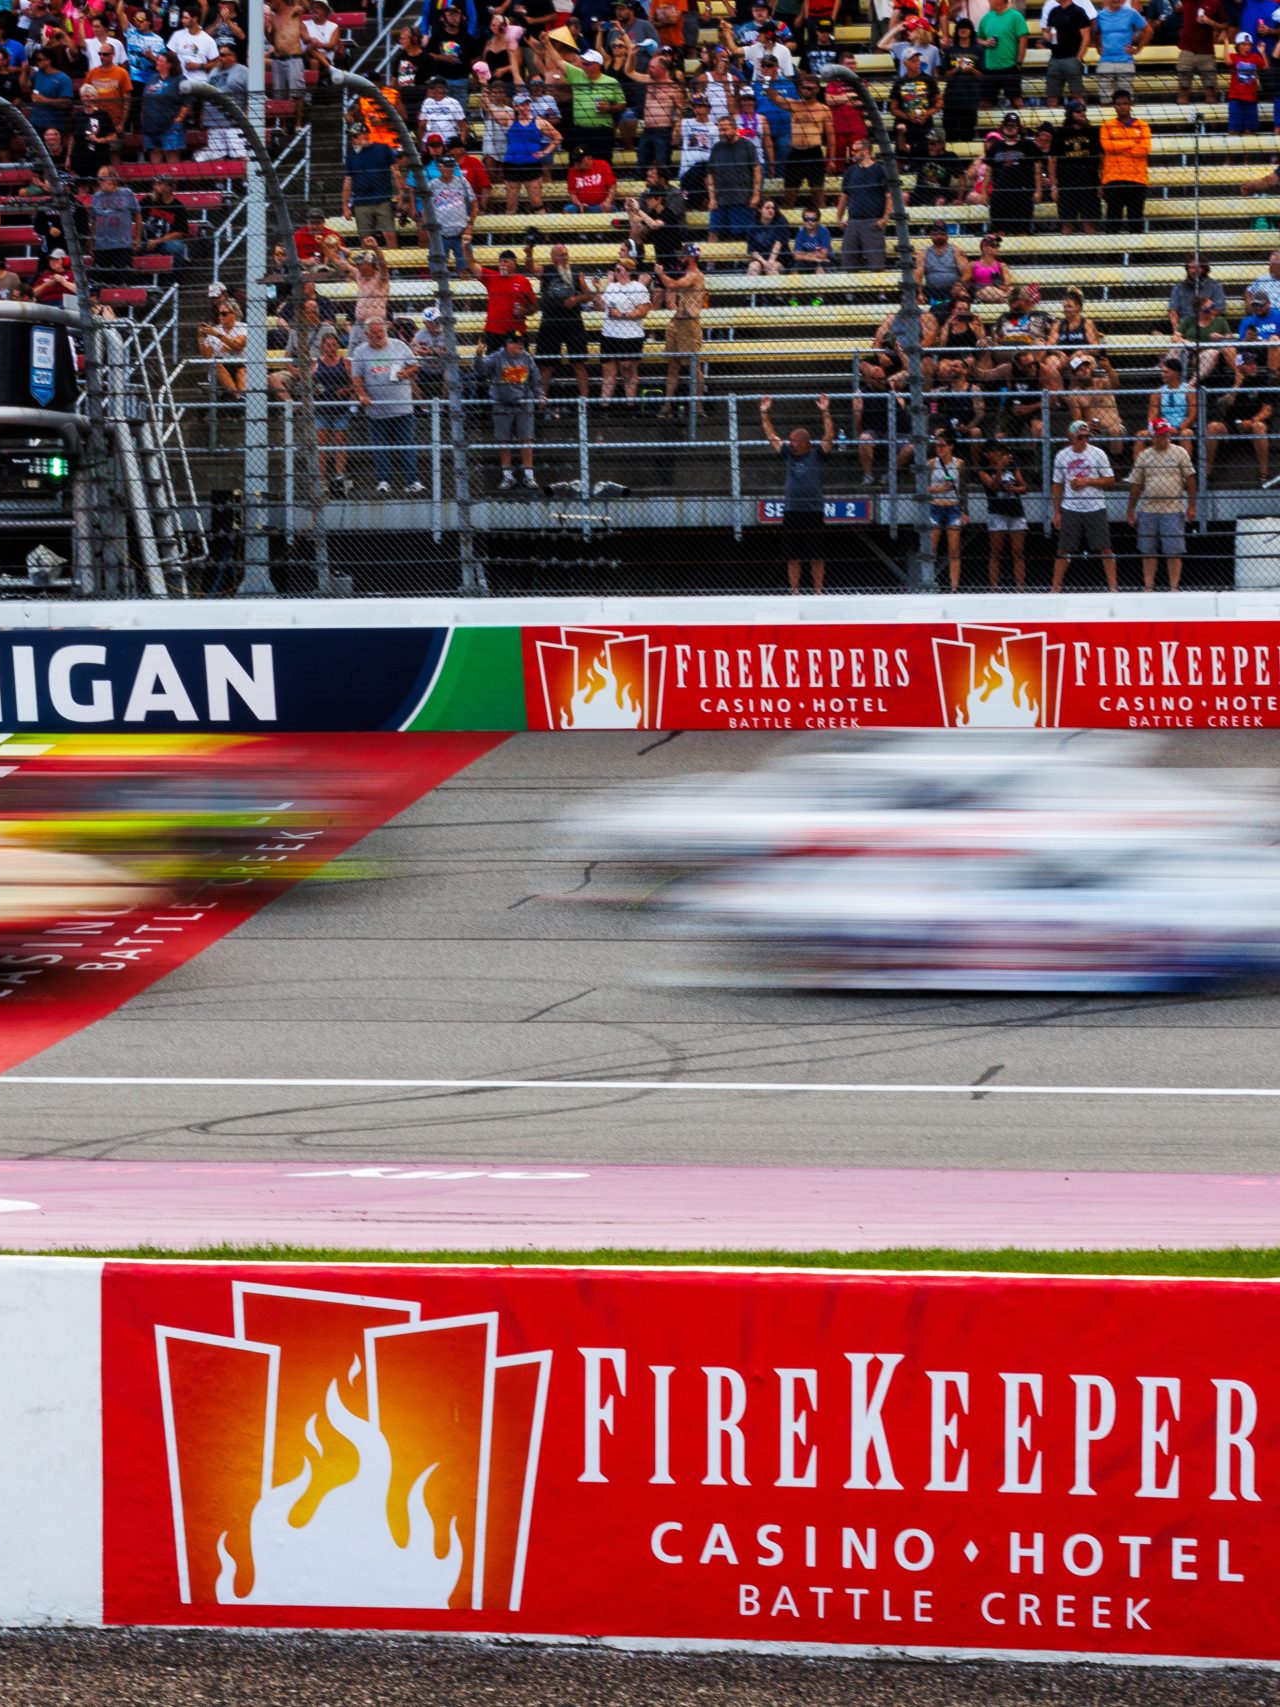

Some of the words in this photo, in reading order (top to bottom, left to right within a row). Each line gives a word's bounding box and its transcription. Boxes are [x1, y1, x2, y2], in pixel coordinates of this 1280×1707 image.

[845, 502, 856, 518] 2
[674, 643, 911, 689] FIREKEEPERS
[1072, 641, 1280, 686] FIREKEEPE
[700, 698, 792, 713] CASINO
[813, 697, 889, 713] HOTEL
[1099, 696, 1194, 712] CASINO
[1215, 696, 1278, 711] HOTE
[729, 717, 792, 729] BATTLE
[805, 716, 861, 729] CREEK
[1129, 715, 1194, 727] BATTLE
[1207, 715, 1264, 727] CREEK
[76, 901, 218, 971] BATTLE
[207, 830, 324, 887] CREEK
[650, 1520, 936, 1573] CASINO
[1008, 1530, 1245, 1583] HOTEL
[738, 1583, 934, 1624] BATTLE
[980, 1591, 1153, 1631] CREEK
